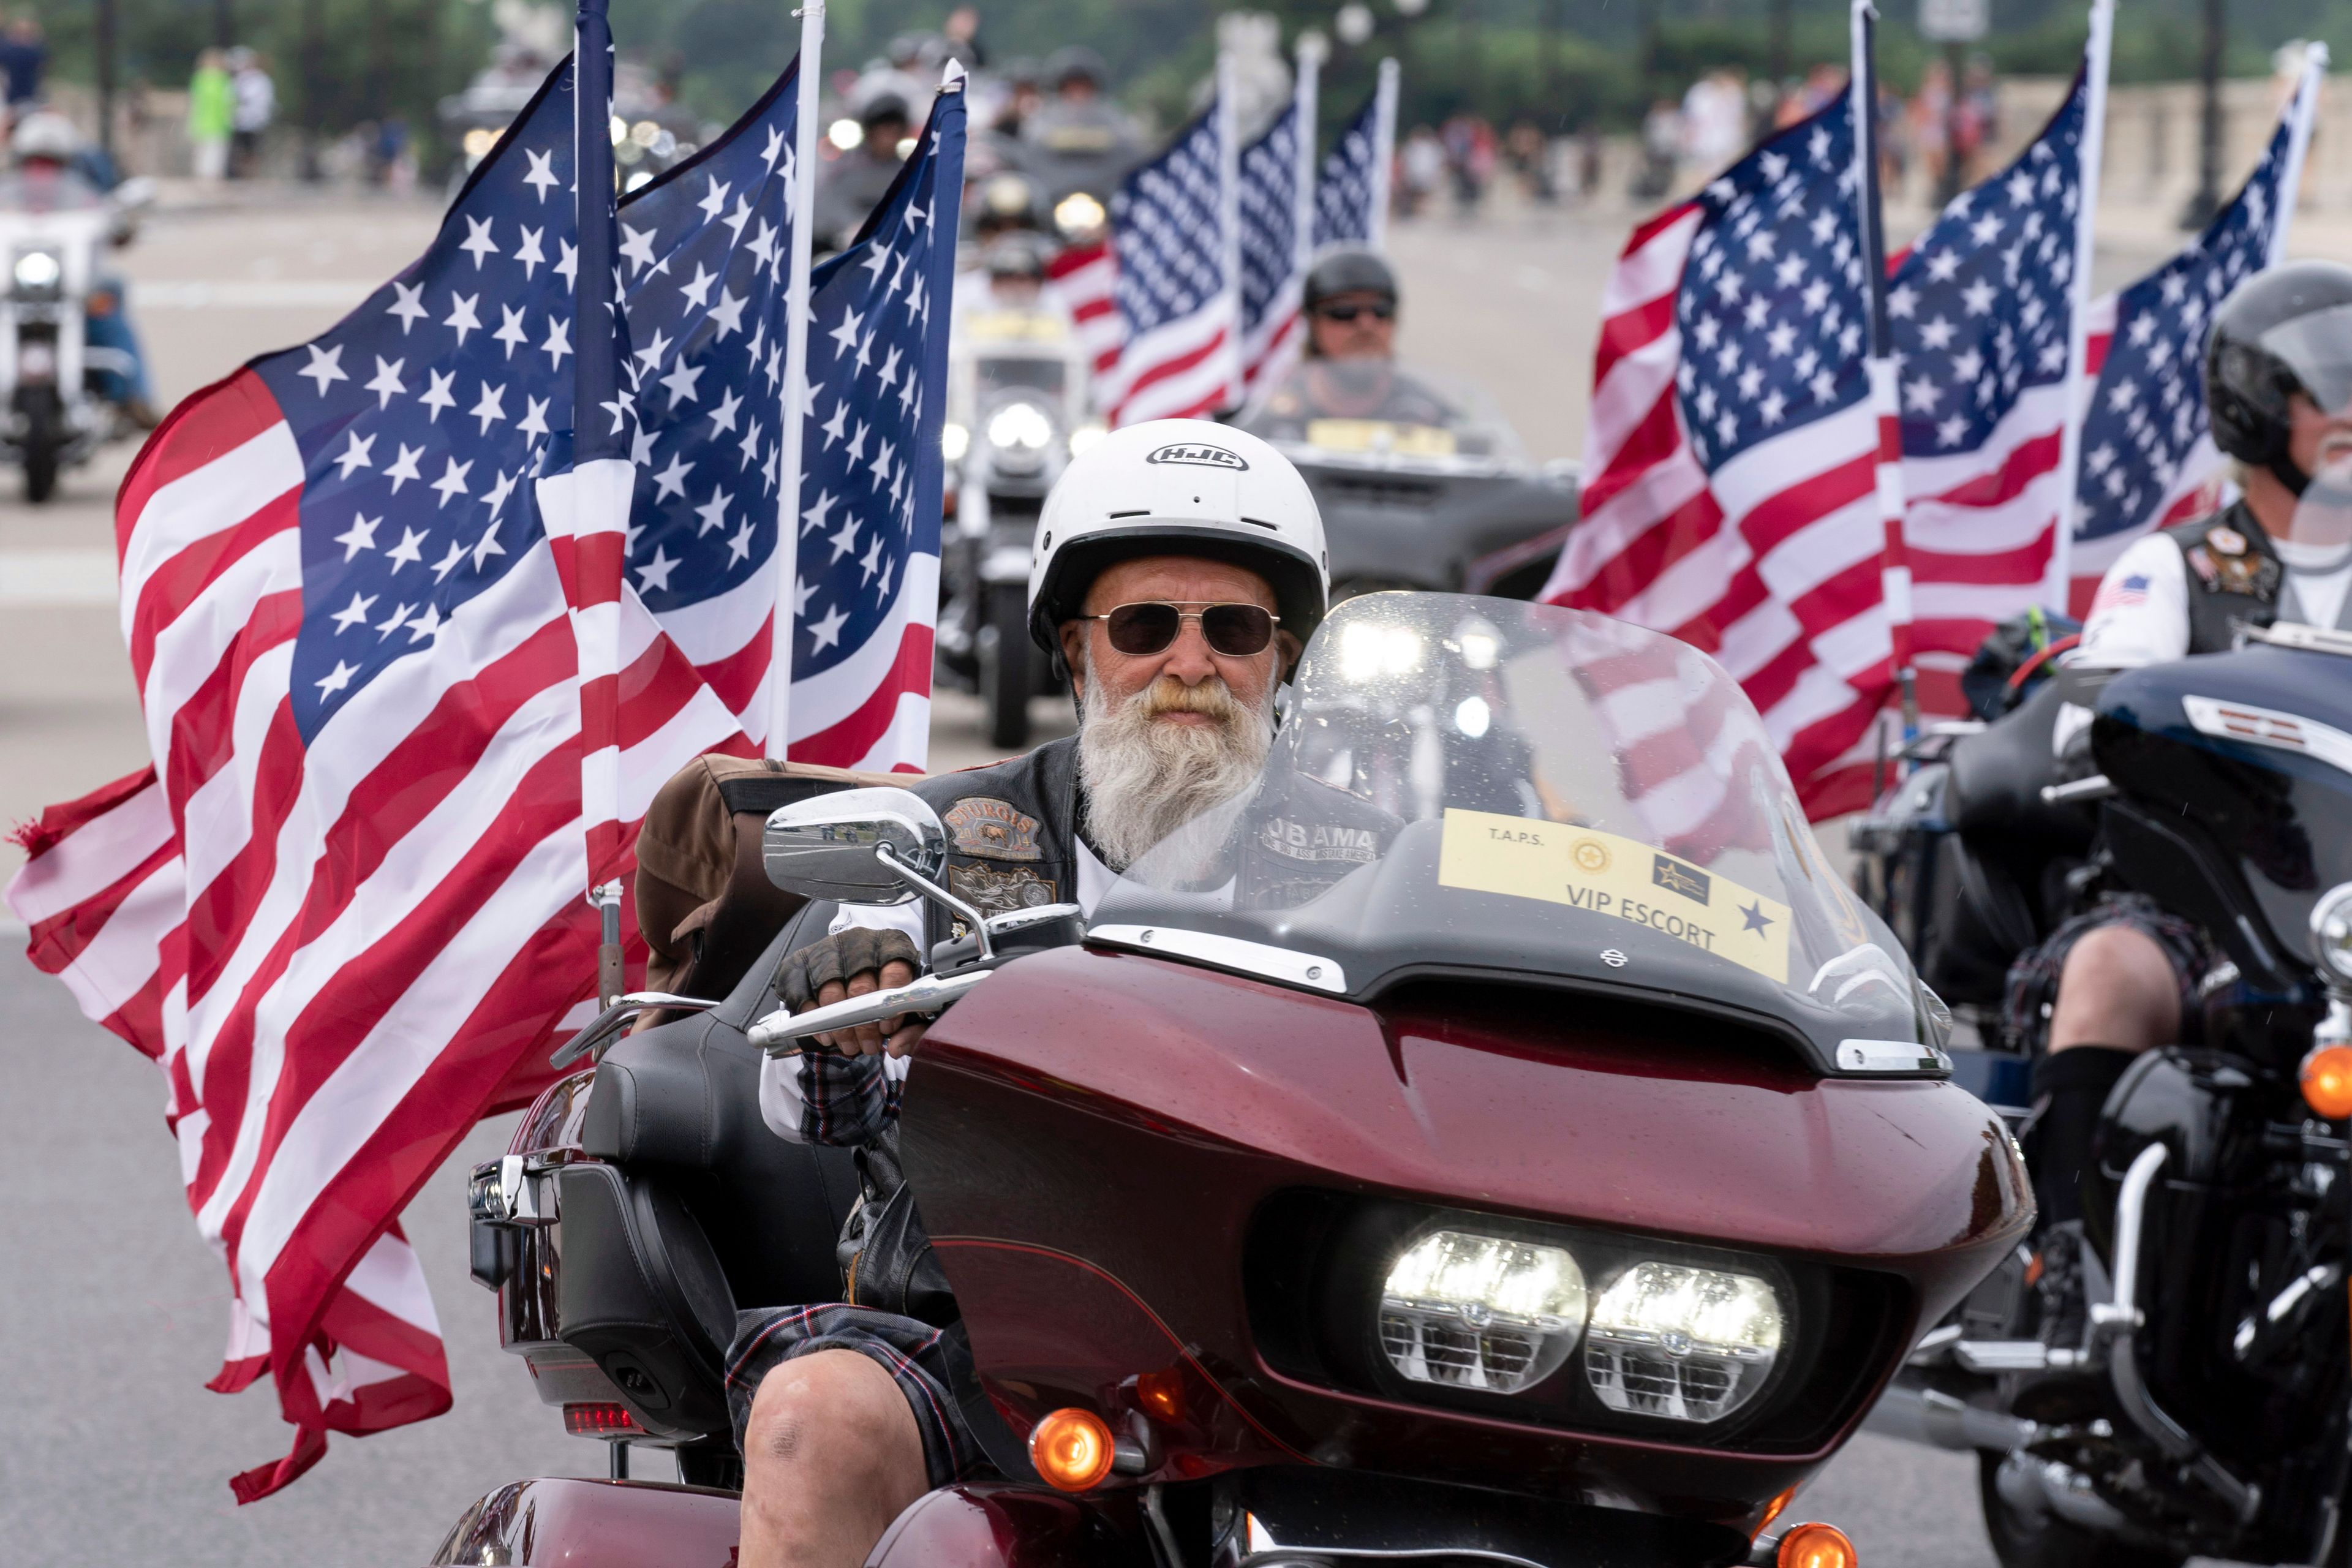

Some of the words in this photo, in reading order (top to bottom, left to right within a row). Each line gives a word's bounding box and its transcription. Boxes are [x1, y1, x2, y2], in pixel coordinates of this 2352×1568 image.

[1160, 448, 1237, 464] HJC
[948, 803, 1034, 834] STURGIS
[1016, 834, 1030, 846] 14
[1488, 827, 1545, 846] T.A.P.S.
[1296, 848, 1311, 859] ASS
[1566, 884, 1611, 910] VIP
[1621, 898, 1717, 950] ESCORT
